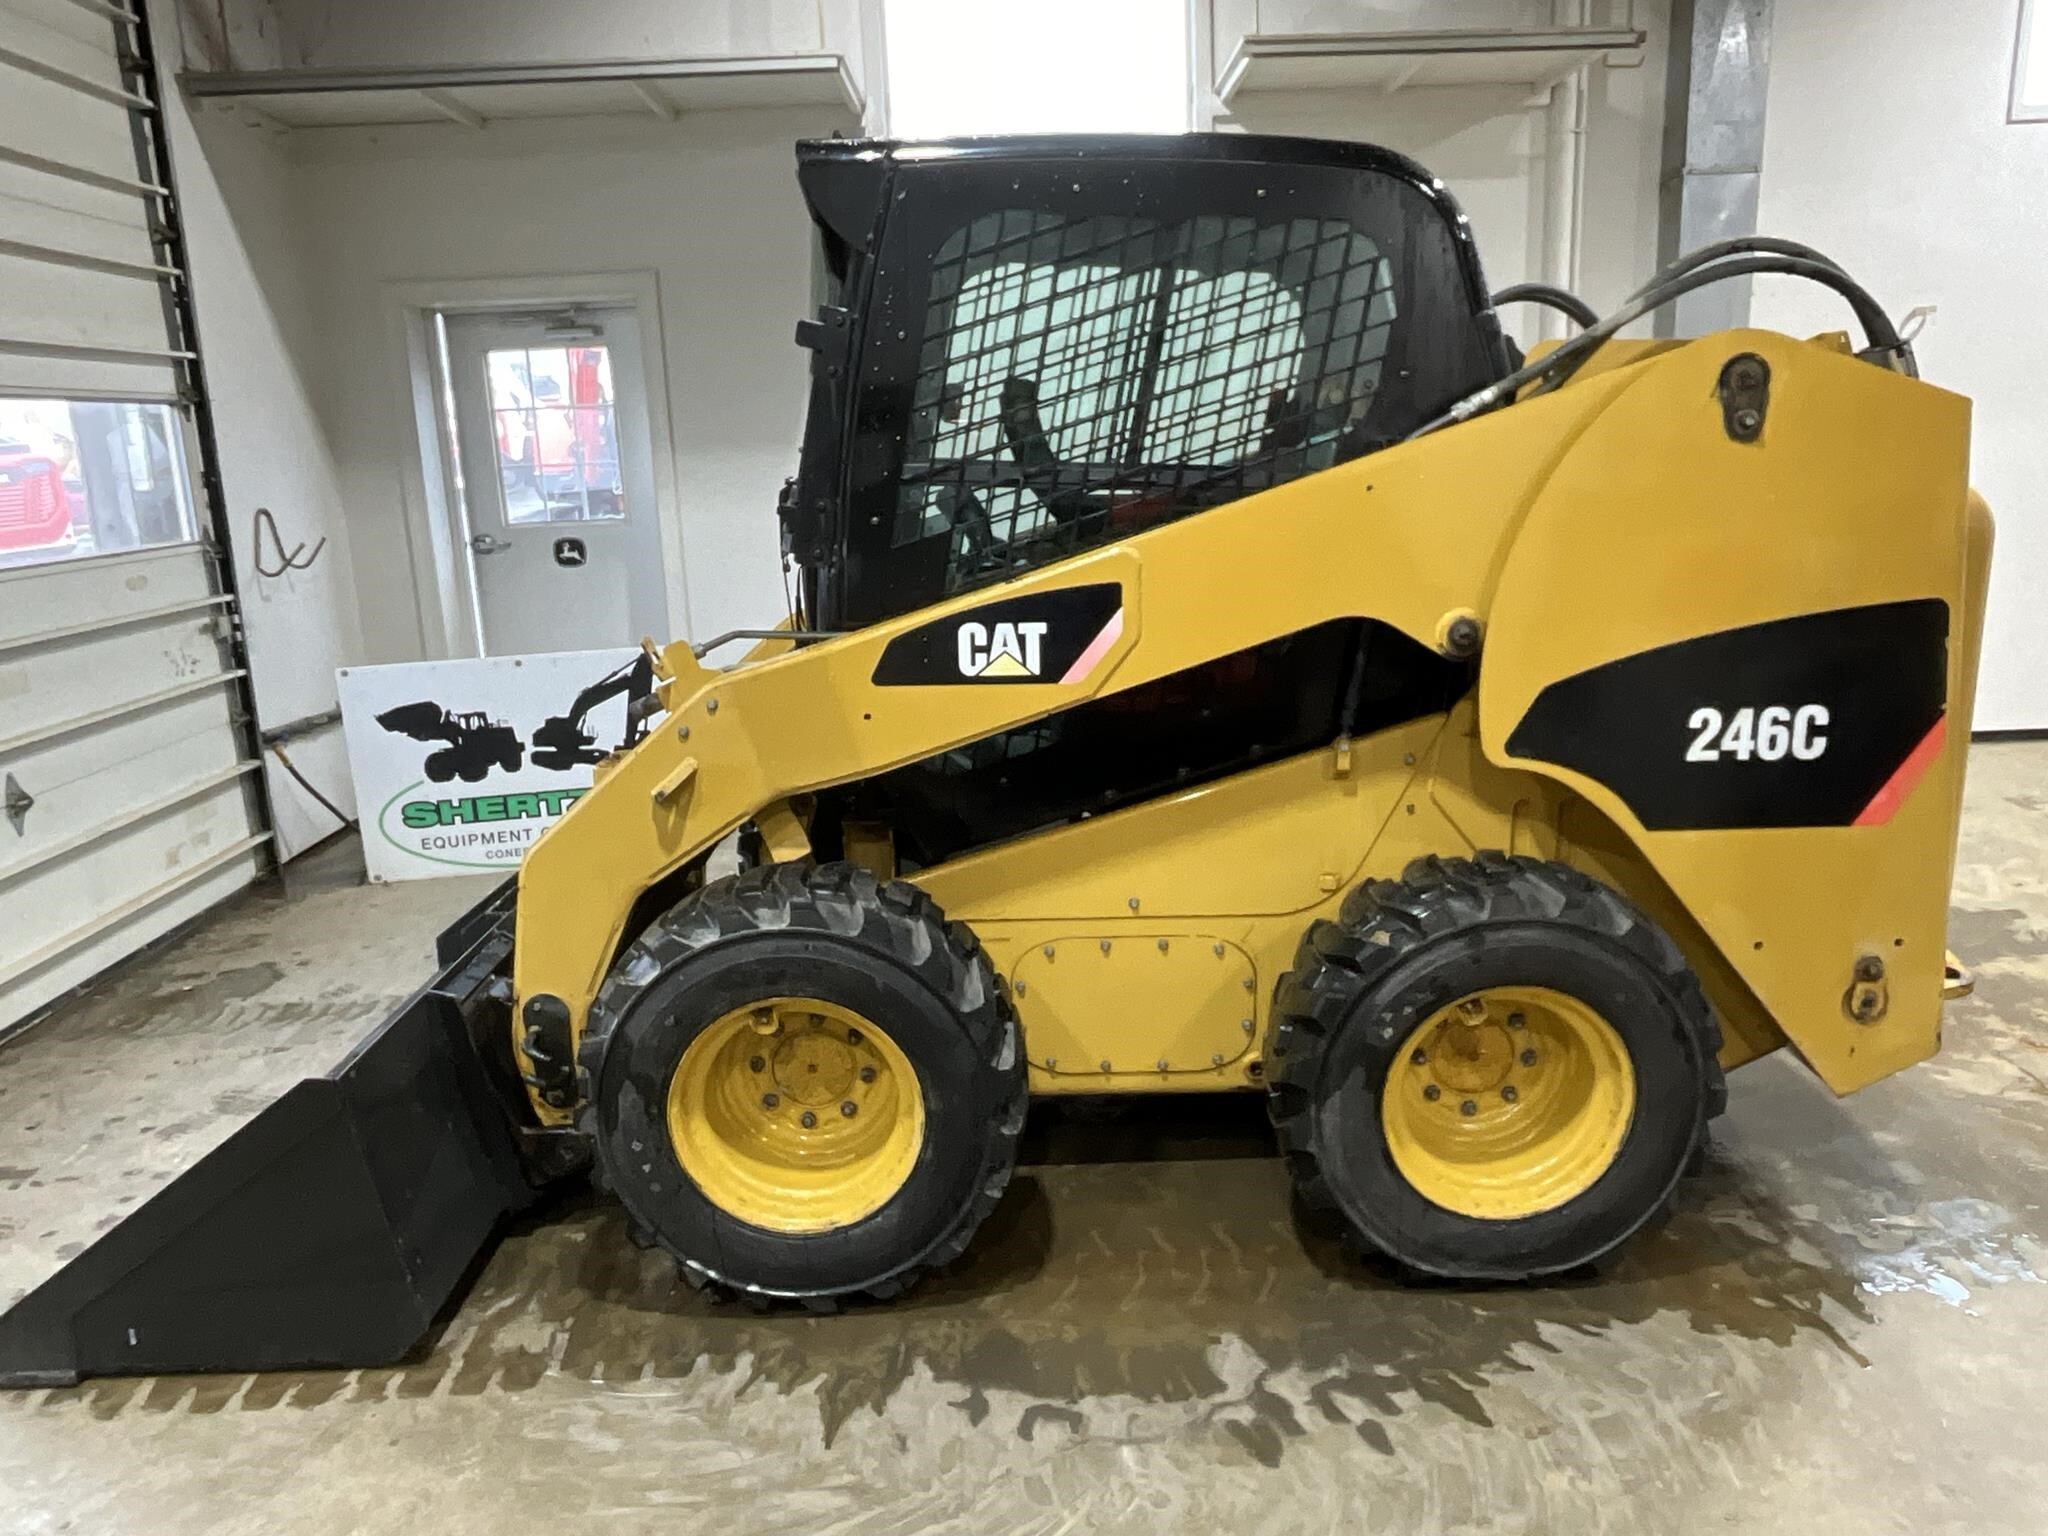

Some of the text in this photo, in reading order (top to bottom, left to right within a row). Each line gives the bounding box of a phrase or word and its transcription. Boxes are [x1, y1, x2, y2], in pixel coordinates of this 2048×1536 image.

[957, 621, 1048, 677] CAT
[1685, 703, 1830, 762] 246C
[420, 828, 533, 851] EQUIPMENT
